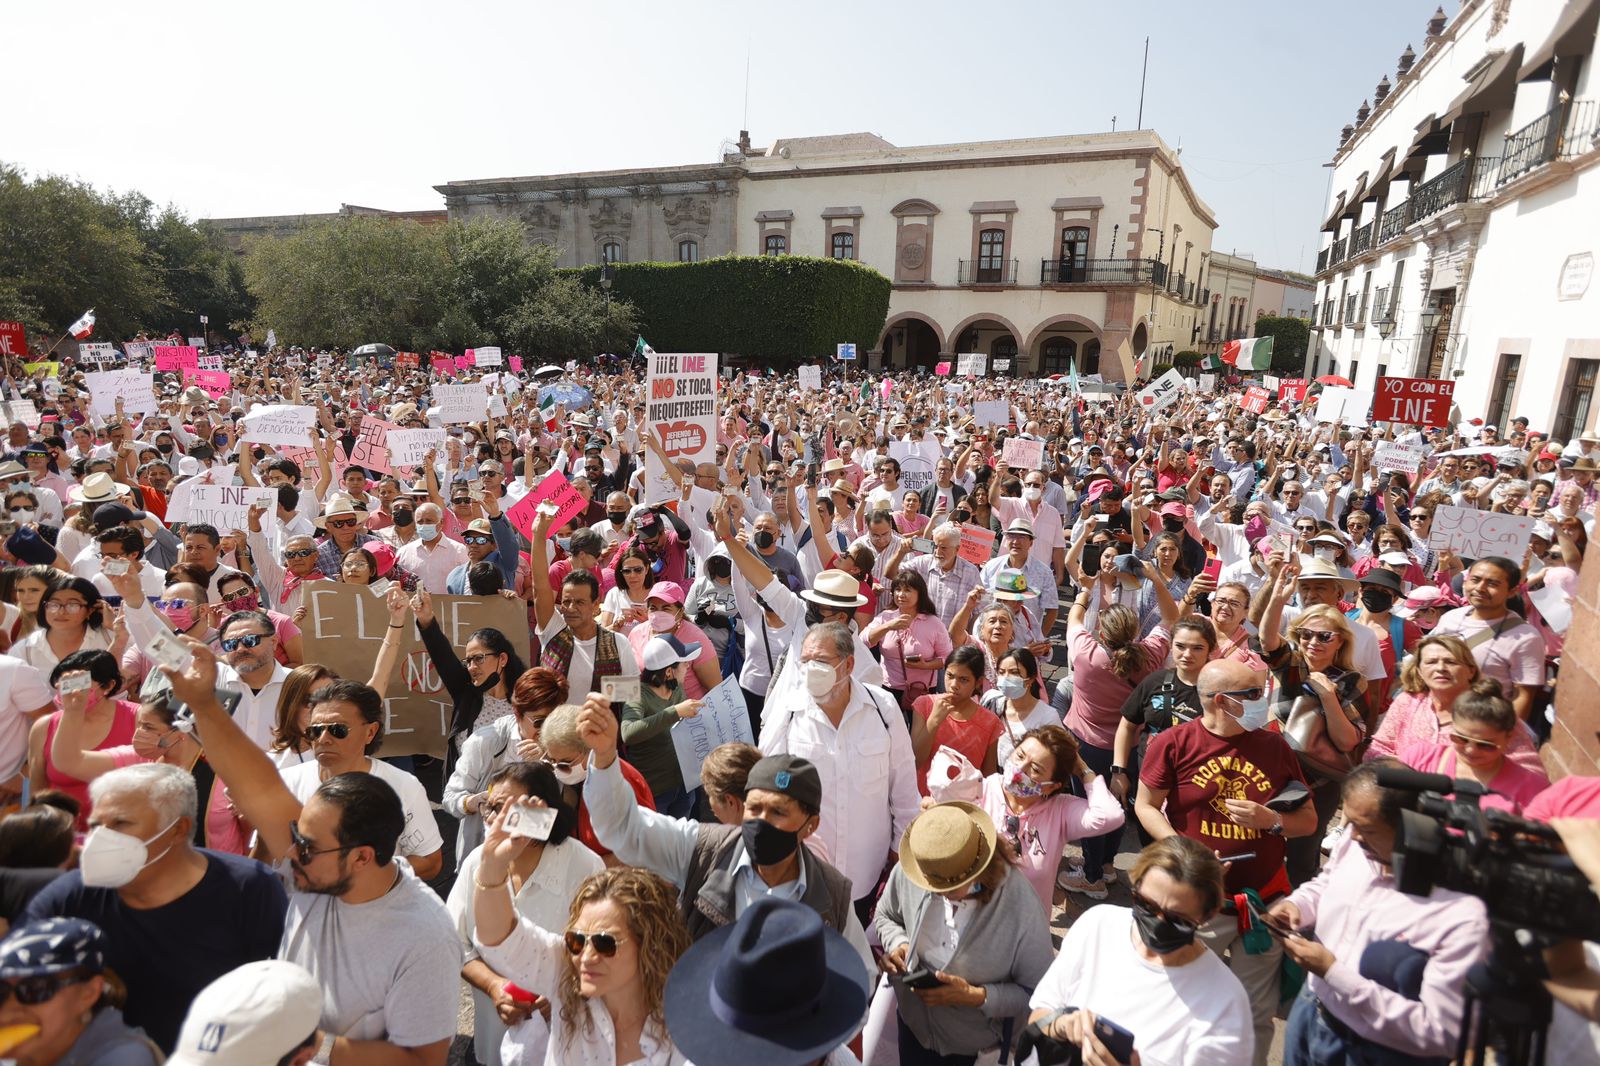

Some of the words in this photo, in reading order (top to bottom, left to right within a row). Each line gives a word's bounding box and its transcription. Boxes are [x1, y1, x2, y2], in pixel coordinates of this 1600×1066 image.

[203, 356, 220, 364] INE
[682, 356, 706, 372] INE
[652, 378, 675, 399] NO
[676, 378, 687, 396] SE
[1152, 379, 1174, 398] INE
[1284, 386, 1298, 400] INE
[1384, 379, 1404, 394] YO
[1410, 382, 1436, 393] CON
[1438, 384, 1453, 395] EL
[650, 399, 714, 422] MEQUETREFE!!!
[1389, 397, 1436, 423] INE
[665, 435, 702, 452] INE
[666, 430, 692, 440] DEFIENDO
[900, 471, 933, 480] #ELINENO
[1374, 461, 1415, 472] CIUDADANO
[191, 488, 206, 500] MI
[220, 487, 249, 506] INE
[515, 510, 530, 528] LA
[311, 590, 383, 640] EL
[407, 652, 443, 693] NO
[1191, 756, 1272, 792] HOGWARTS
